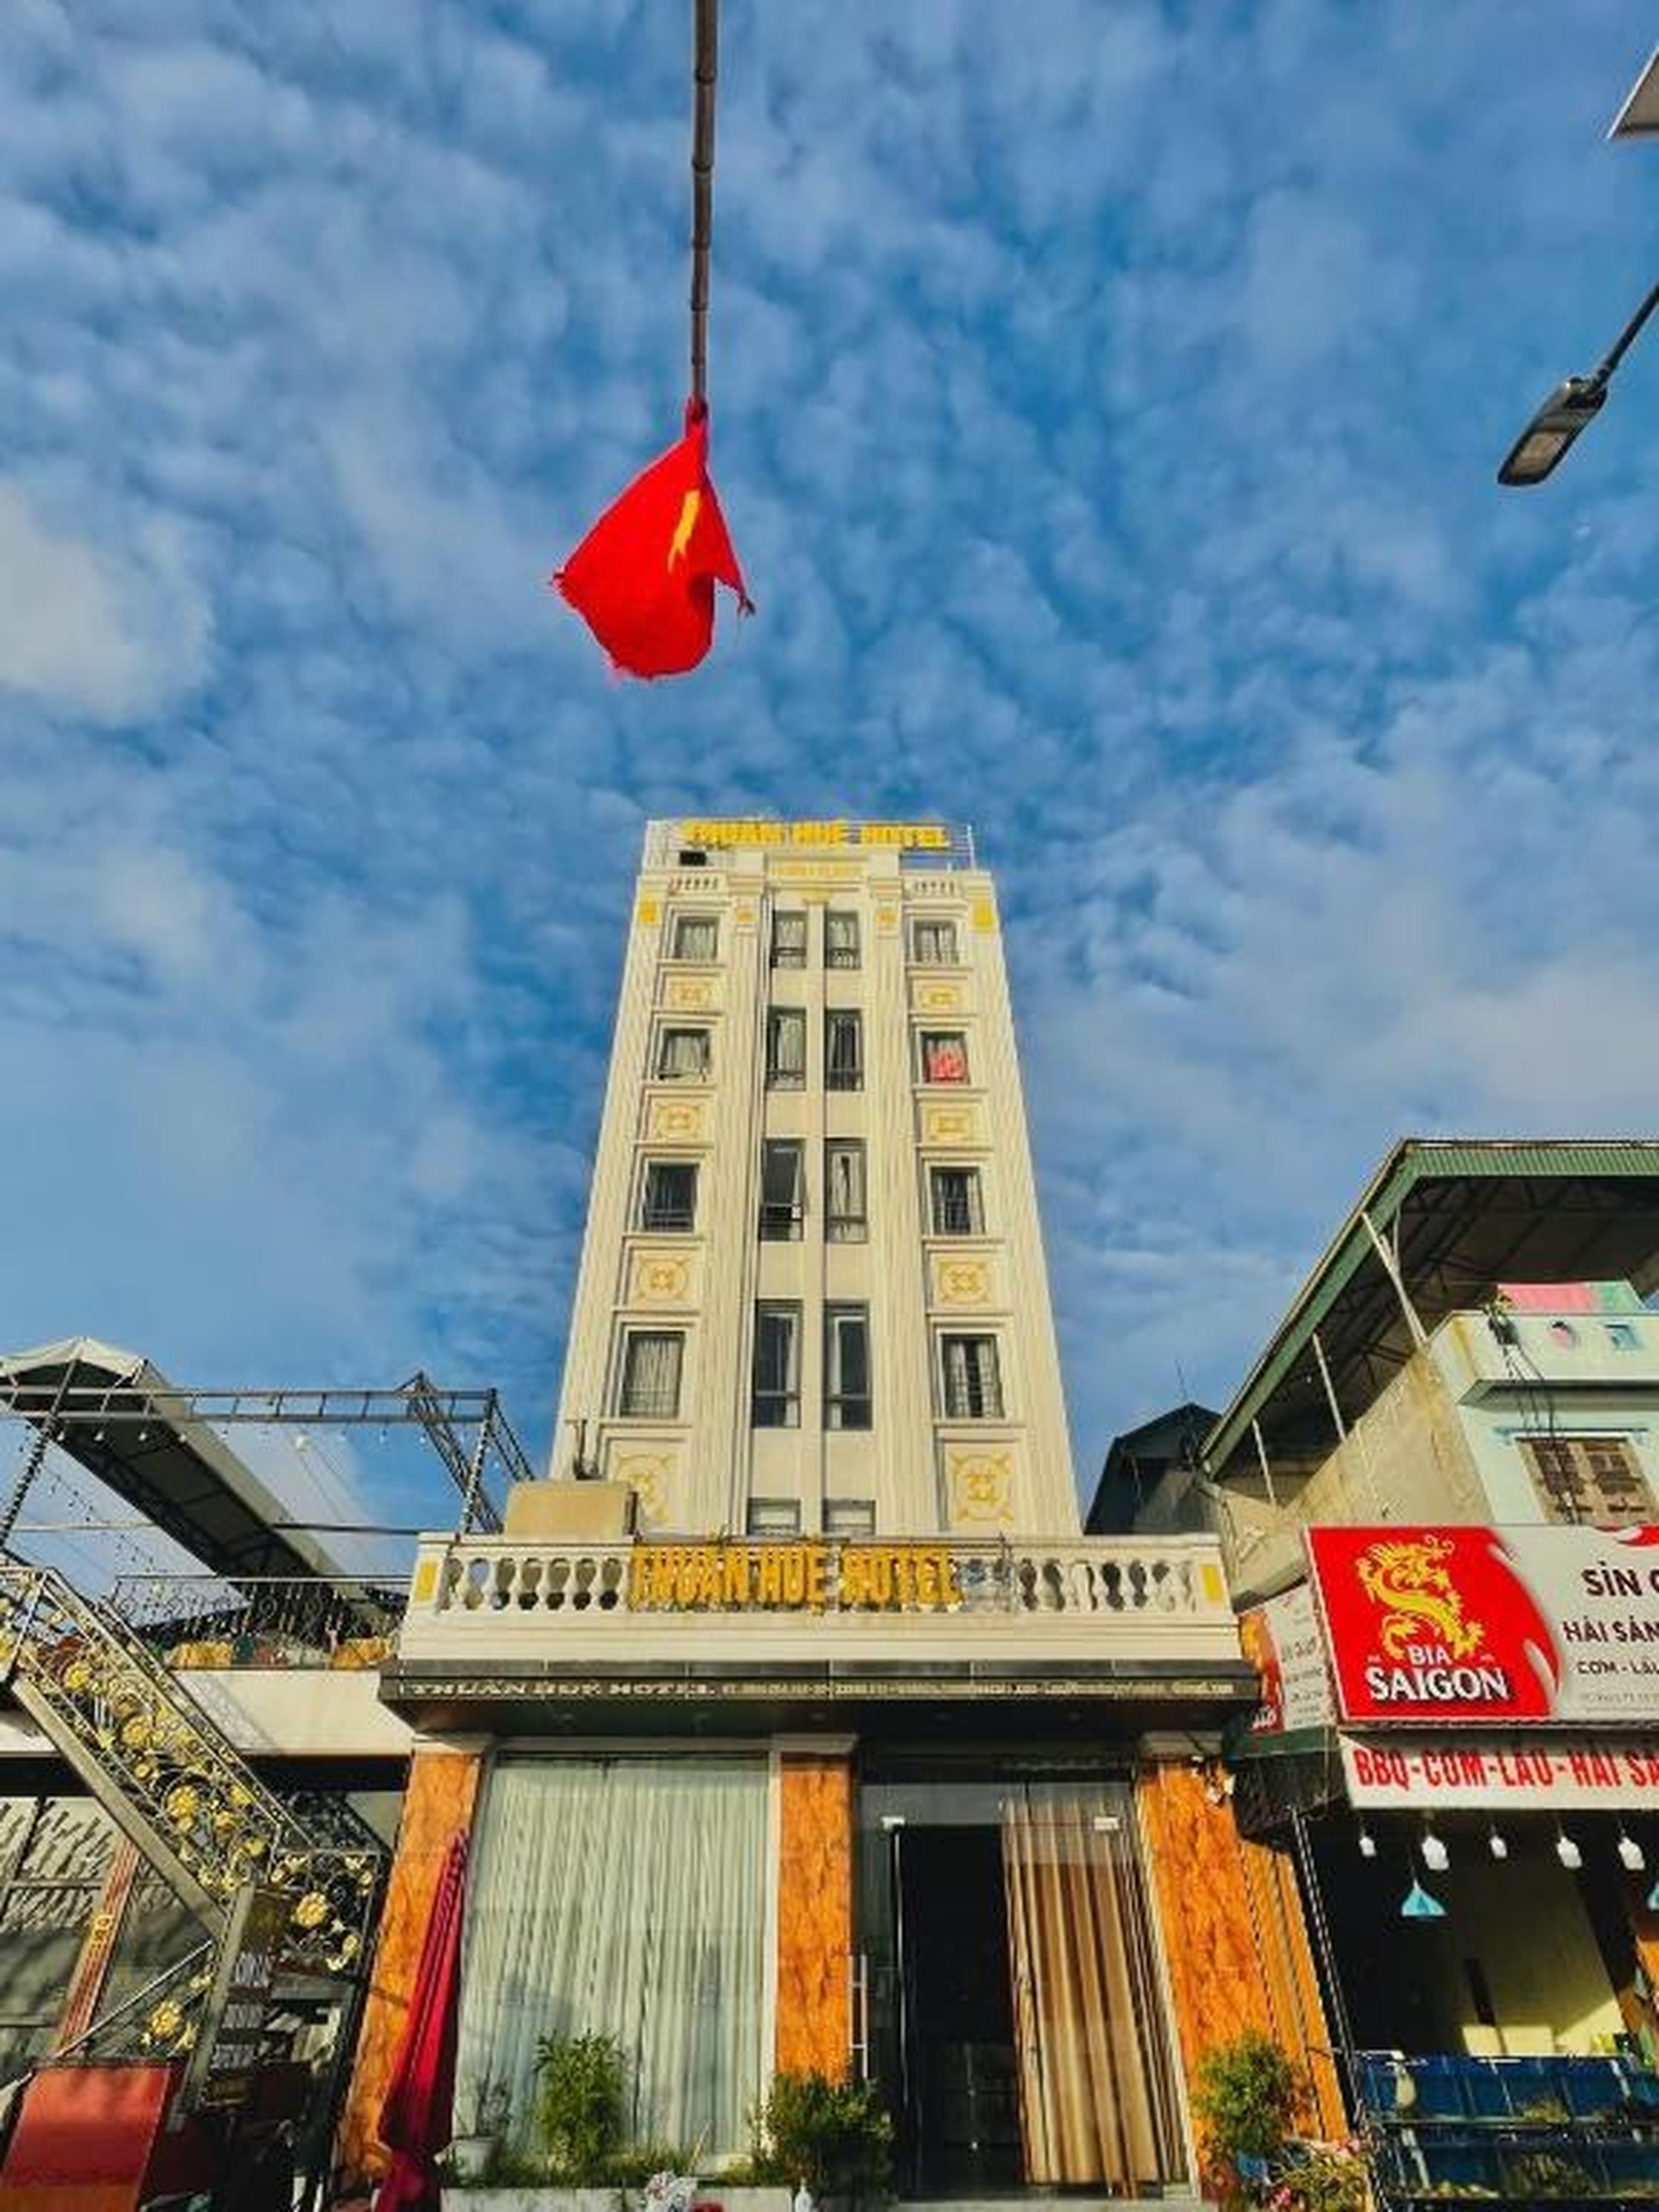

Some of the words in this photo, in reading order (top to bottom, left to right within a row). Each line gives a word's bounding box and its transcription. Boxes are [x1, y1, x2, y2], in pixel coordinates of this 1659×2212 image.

[842, 1548, 963, 1605] HOTEL
[1581, 1560, 1643, 1596] SÌN
[1408, 1644, 1452, 1665] BIA
[1365, 1667, 1508, 1700] SAIGON
